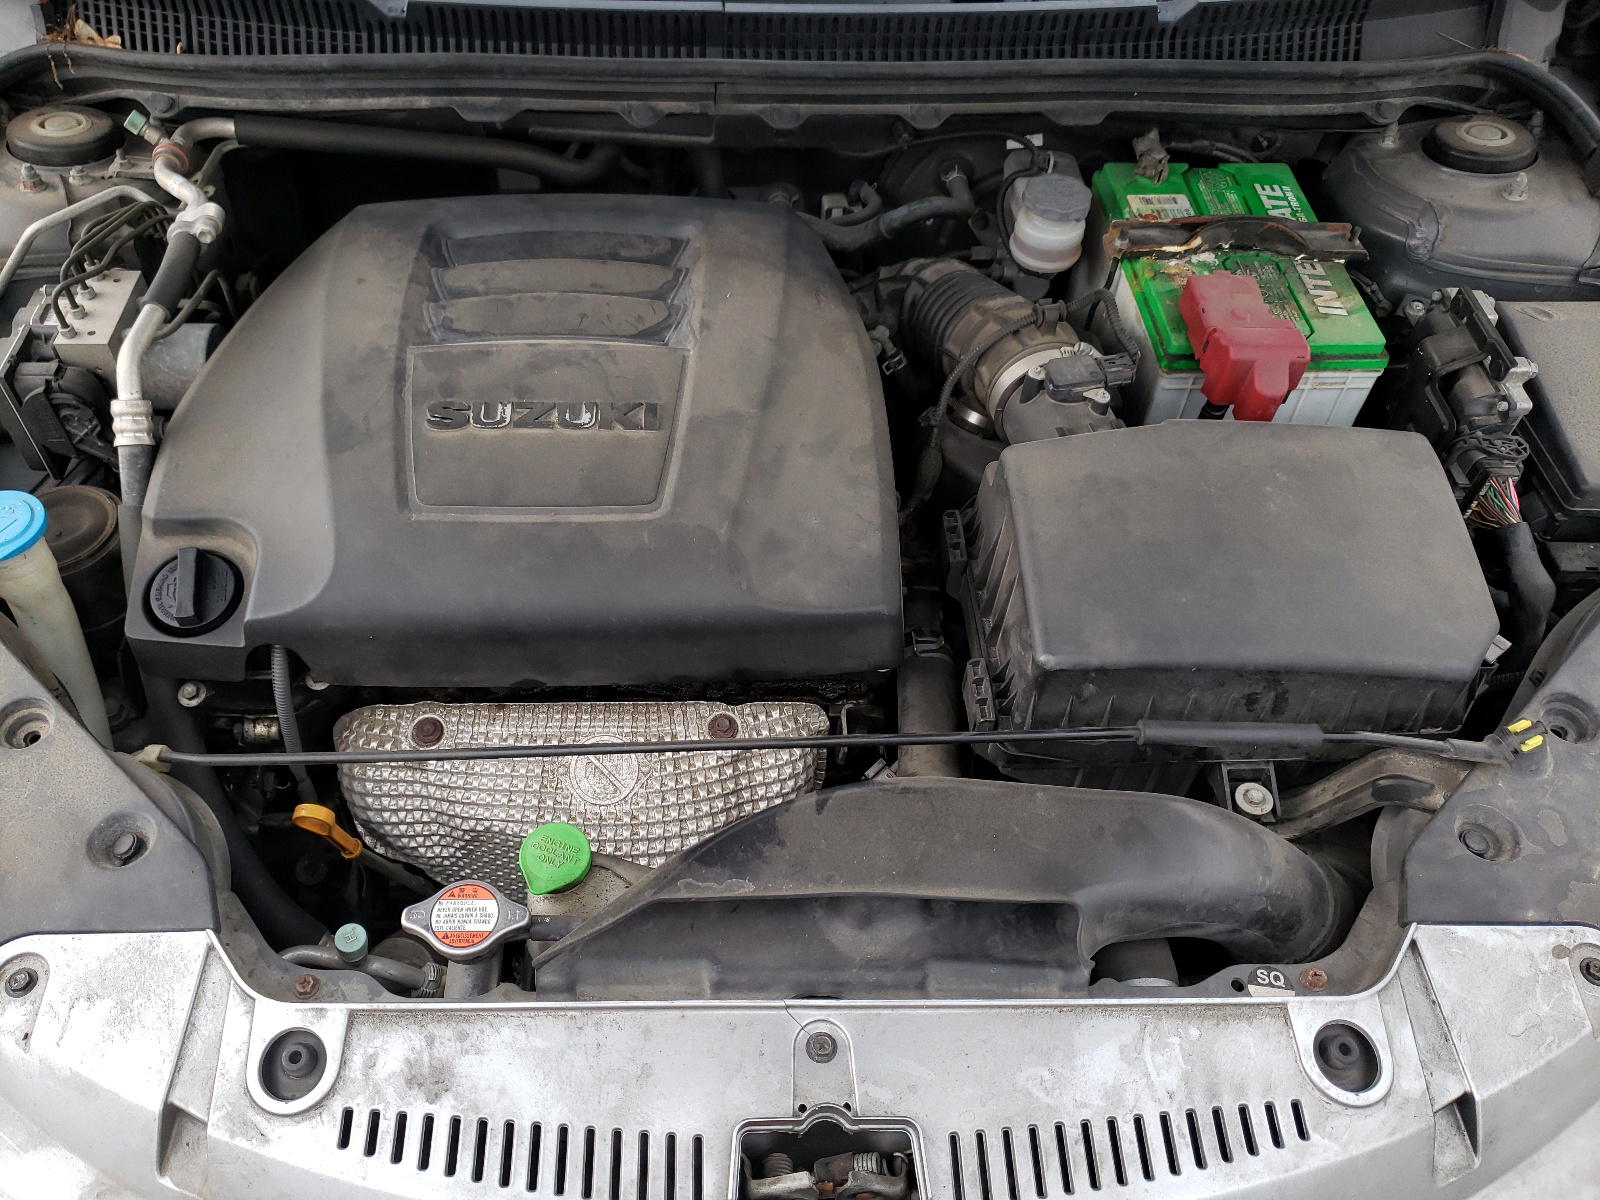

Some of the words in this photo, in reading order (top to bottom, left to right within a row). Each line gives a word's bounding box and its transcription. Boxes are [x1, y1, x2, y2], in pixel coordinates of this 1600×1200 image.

[425, 401, 661, 431] SUZUKI
[532, 842, 582, 865] COOLANT
[541, 835, 580, 855] ENGINE
[537, 854, 564, 868] ONLY
[1256, 968, 1286, 988] SQ
